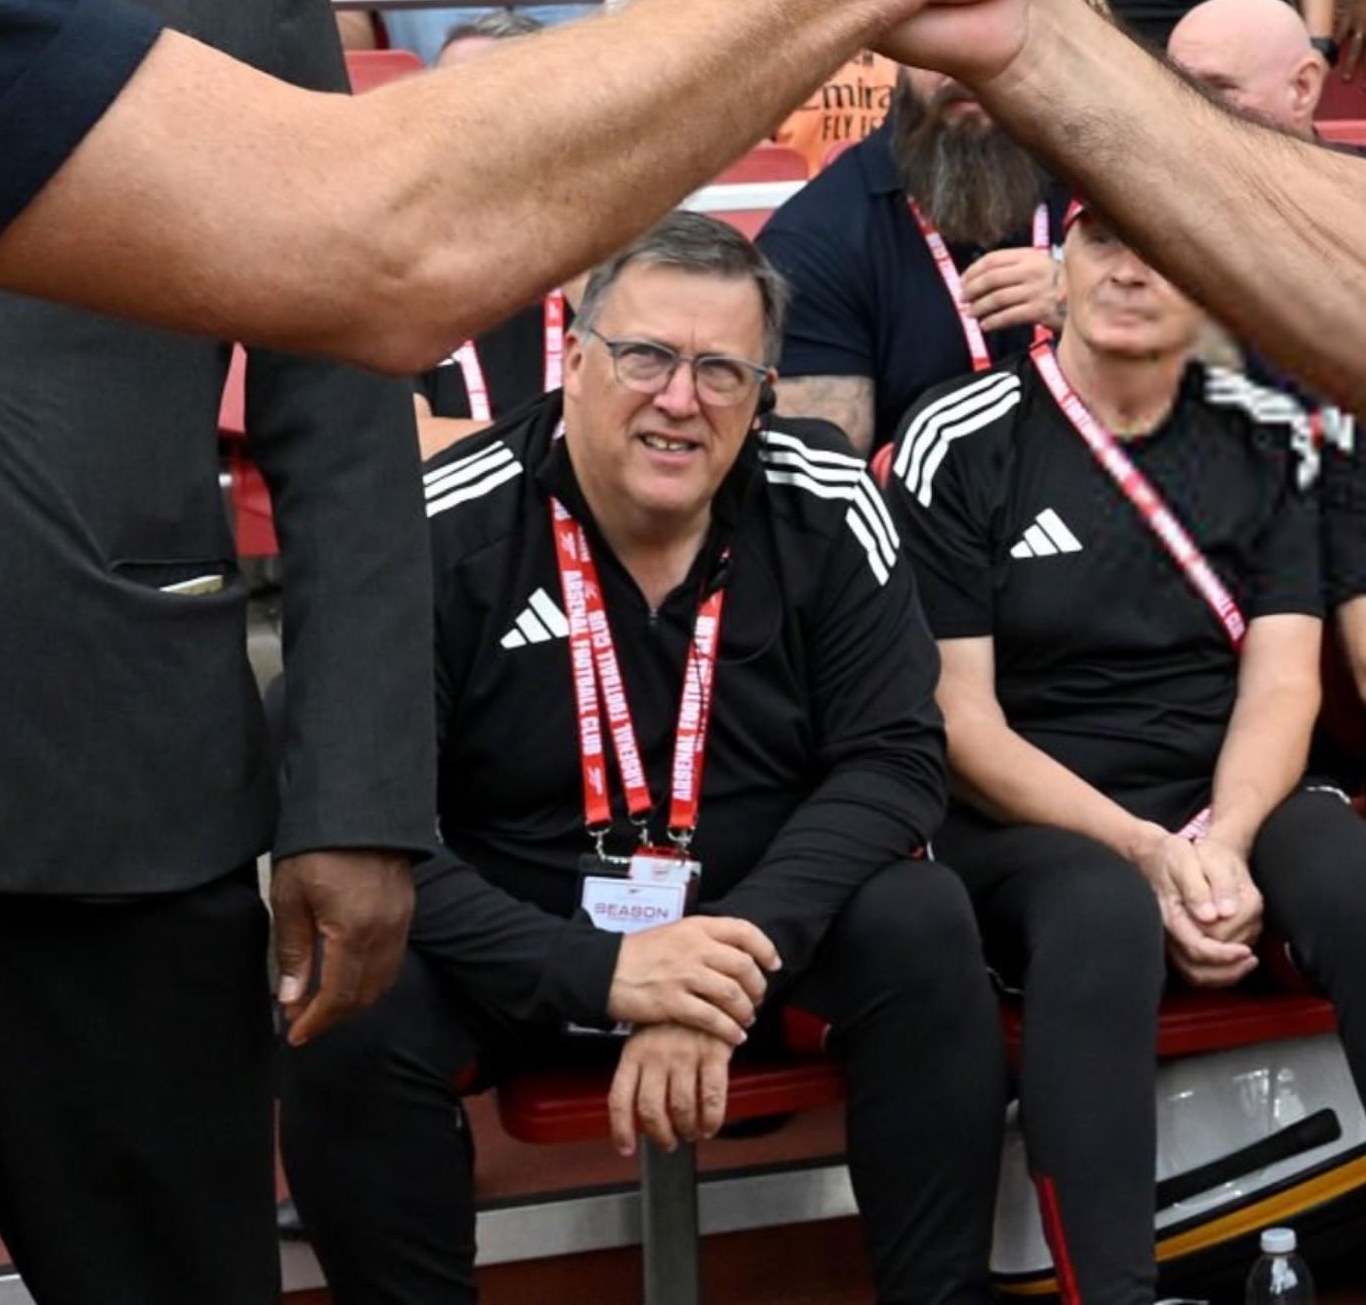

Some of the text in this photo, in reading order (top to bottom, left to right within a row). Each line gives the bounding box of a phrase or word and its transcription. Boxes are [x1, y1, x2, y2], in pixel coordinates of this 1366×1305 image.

[821, 115, 855, 141] FLY
[561, 569, 588, 635] ARSENAL
[572, 638, 598, 713] FOOTBALL
[587, 609, 645, 789] ARSENAL FOOTBALL CLUB
[580, 715, 603, 756] CLUB
[672, 734, 697, 802] ARSENAL
[594, 902, 670, 919] SEASON
